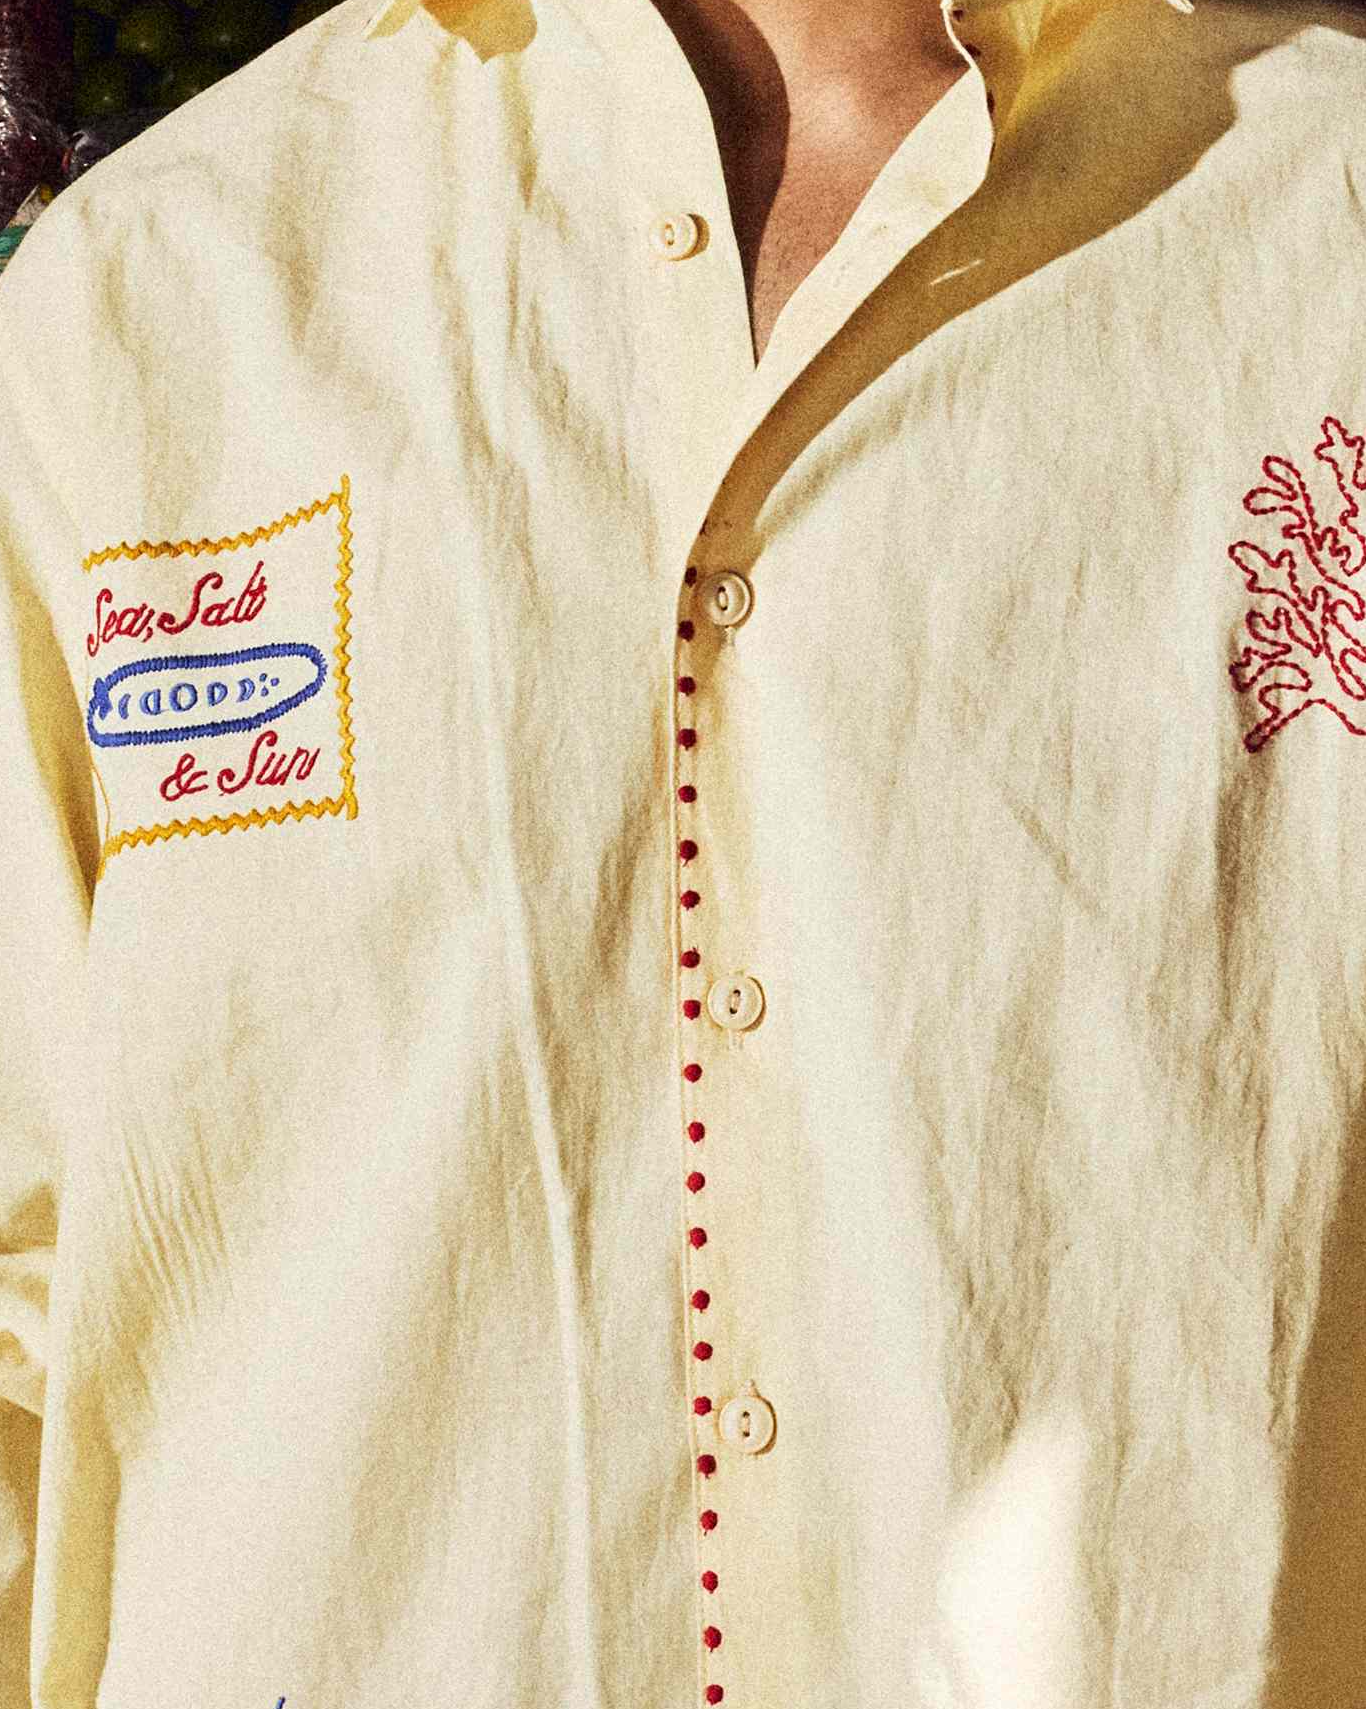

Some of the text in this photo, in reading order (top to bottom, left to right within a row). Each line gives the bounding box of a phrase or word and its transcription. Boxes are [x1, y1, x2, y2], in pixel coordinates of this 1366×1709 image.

[158, 560, 269, 636] Salt
[159, 729, 321, 802] & Sun
